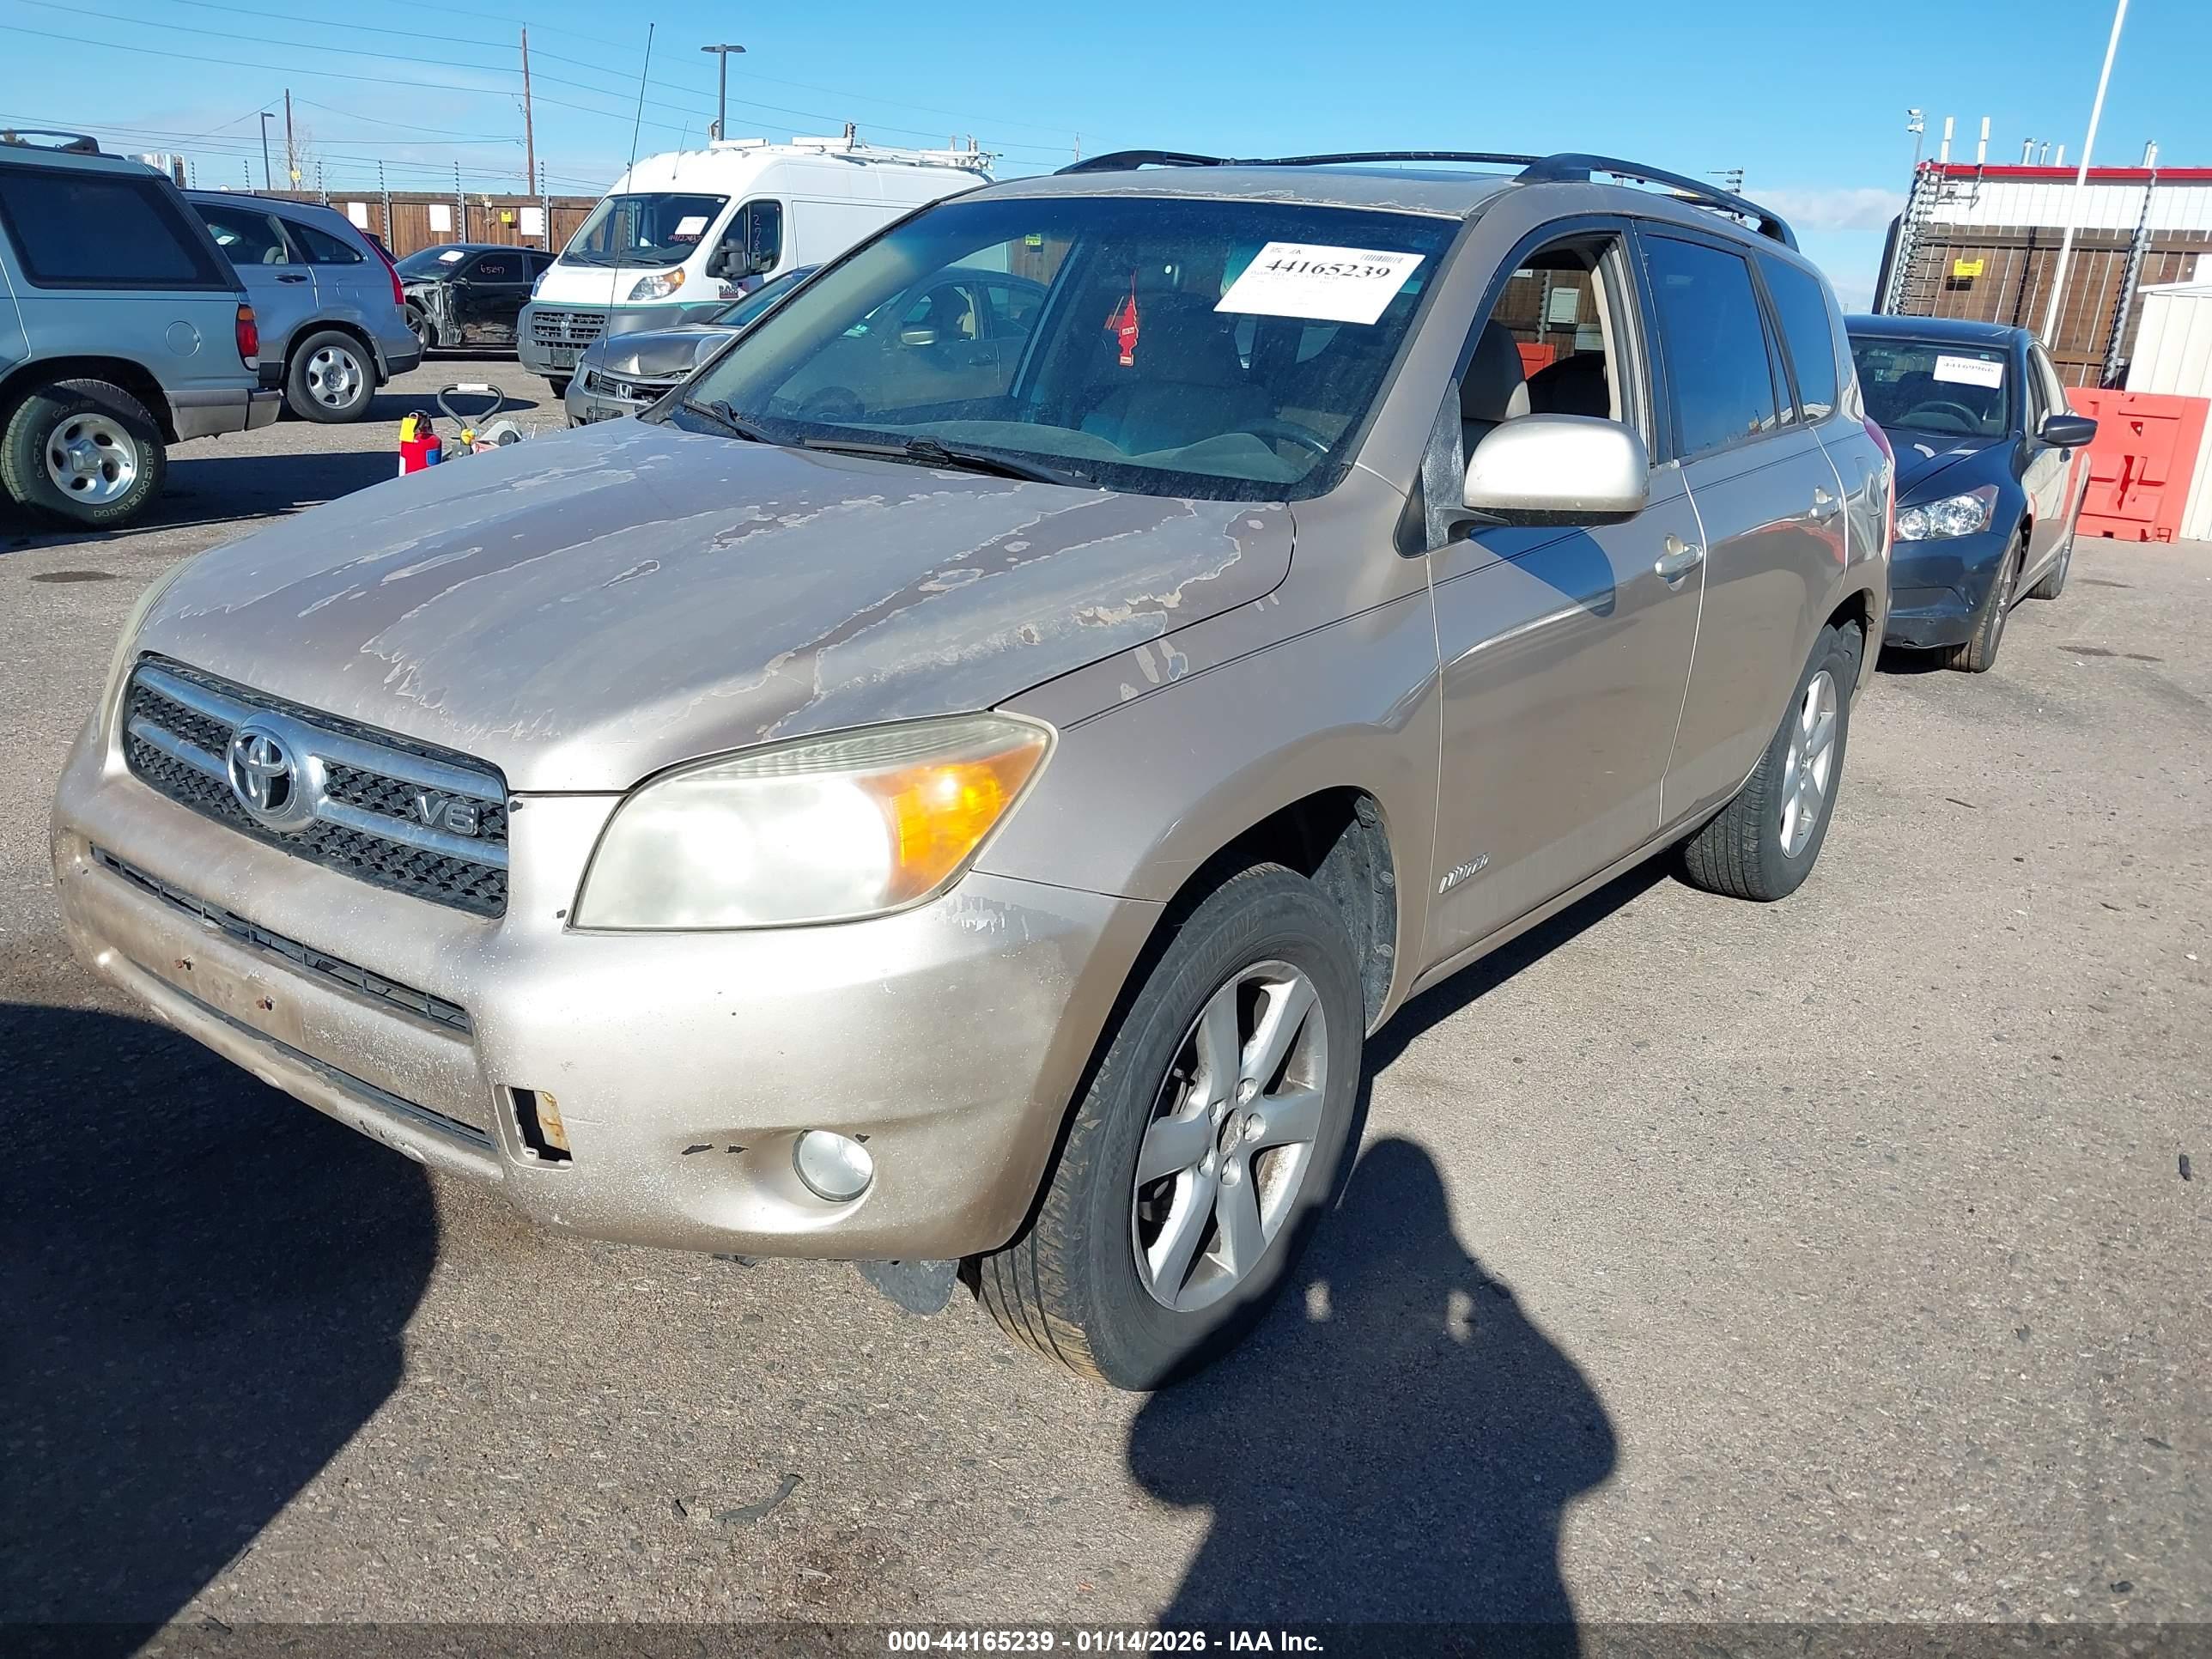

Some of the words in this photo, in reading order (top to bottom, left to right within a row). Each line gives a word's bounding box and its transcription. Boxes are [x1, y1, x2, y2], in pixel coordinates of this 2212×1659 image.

[1265, 258, 1391, 279] 44165239
[94, 439, 155, 517] MICHELIN
[415, 791, 477, 836] V6
